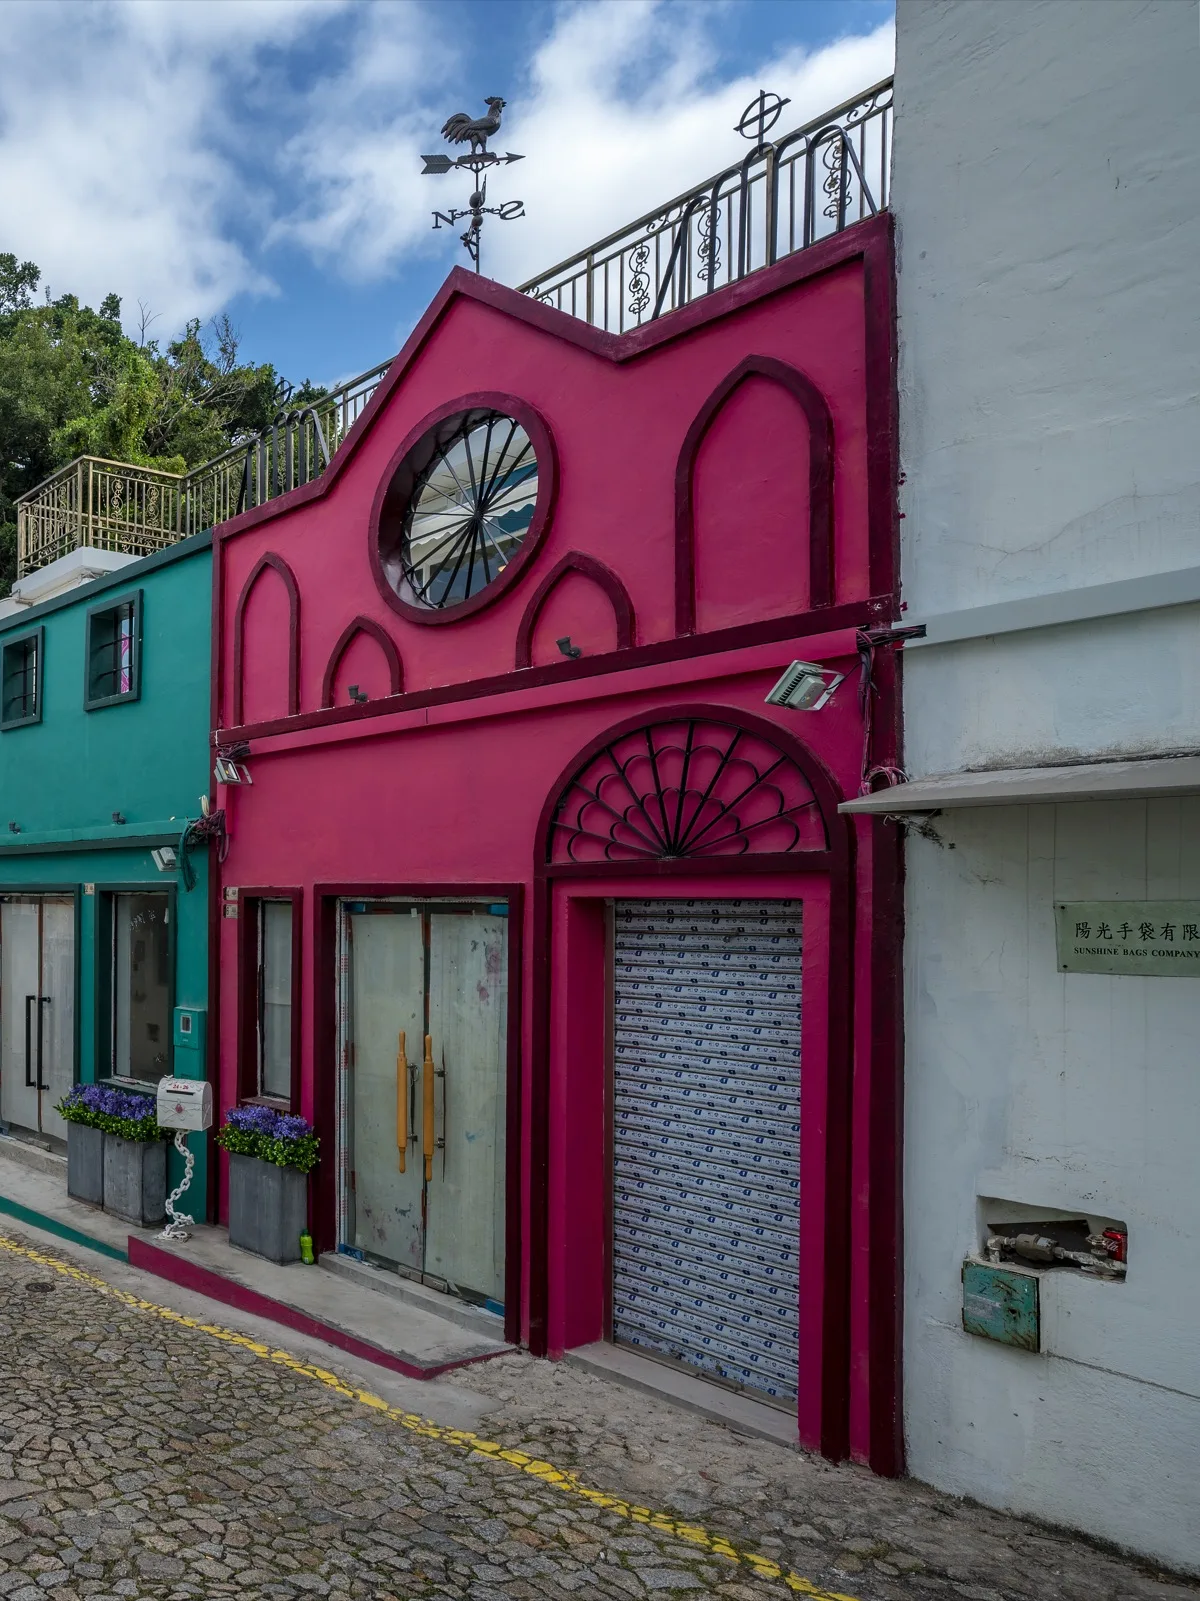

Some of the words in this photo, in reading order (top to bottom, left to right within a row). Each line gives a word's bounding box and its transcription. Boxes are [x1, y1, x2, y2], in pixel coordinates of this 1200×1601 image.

[431, 209, 457, 229] N
[1075, 921, 1200, 942] 陽光手袋有限
[1073, 946, 1119, 956] SUNSHINE
[1123, 948, 1148, 957] BAGS
[1151, 949, 1200, 958] COMPANY
